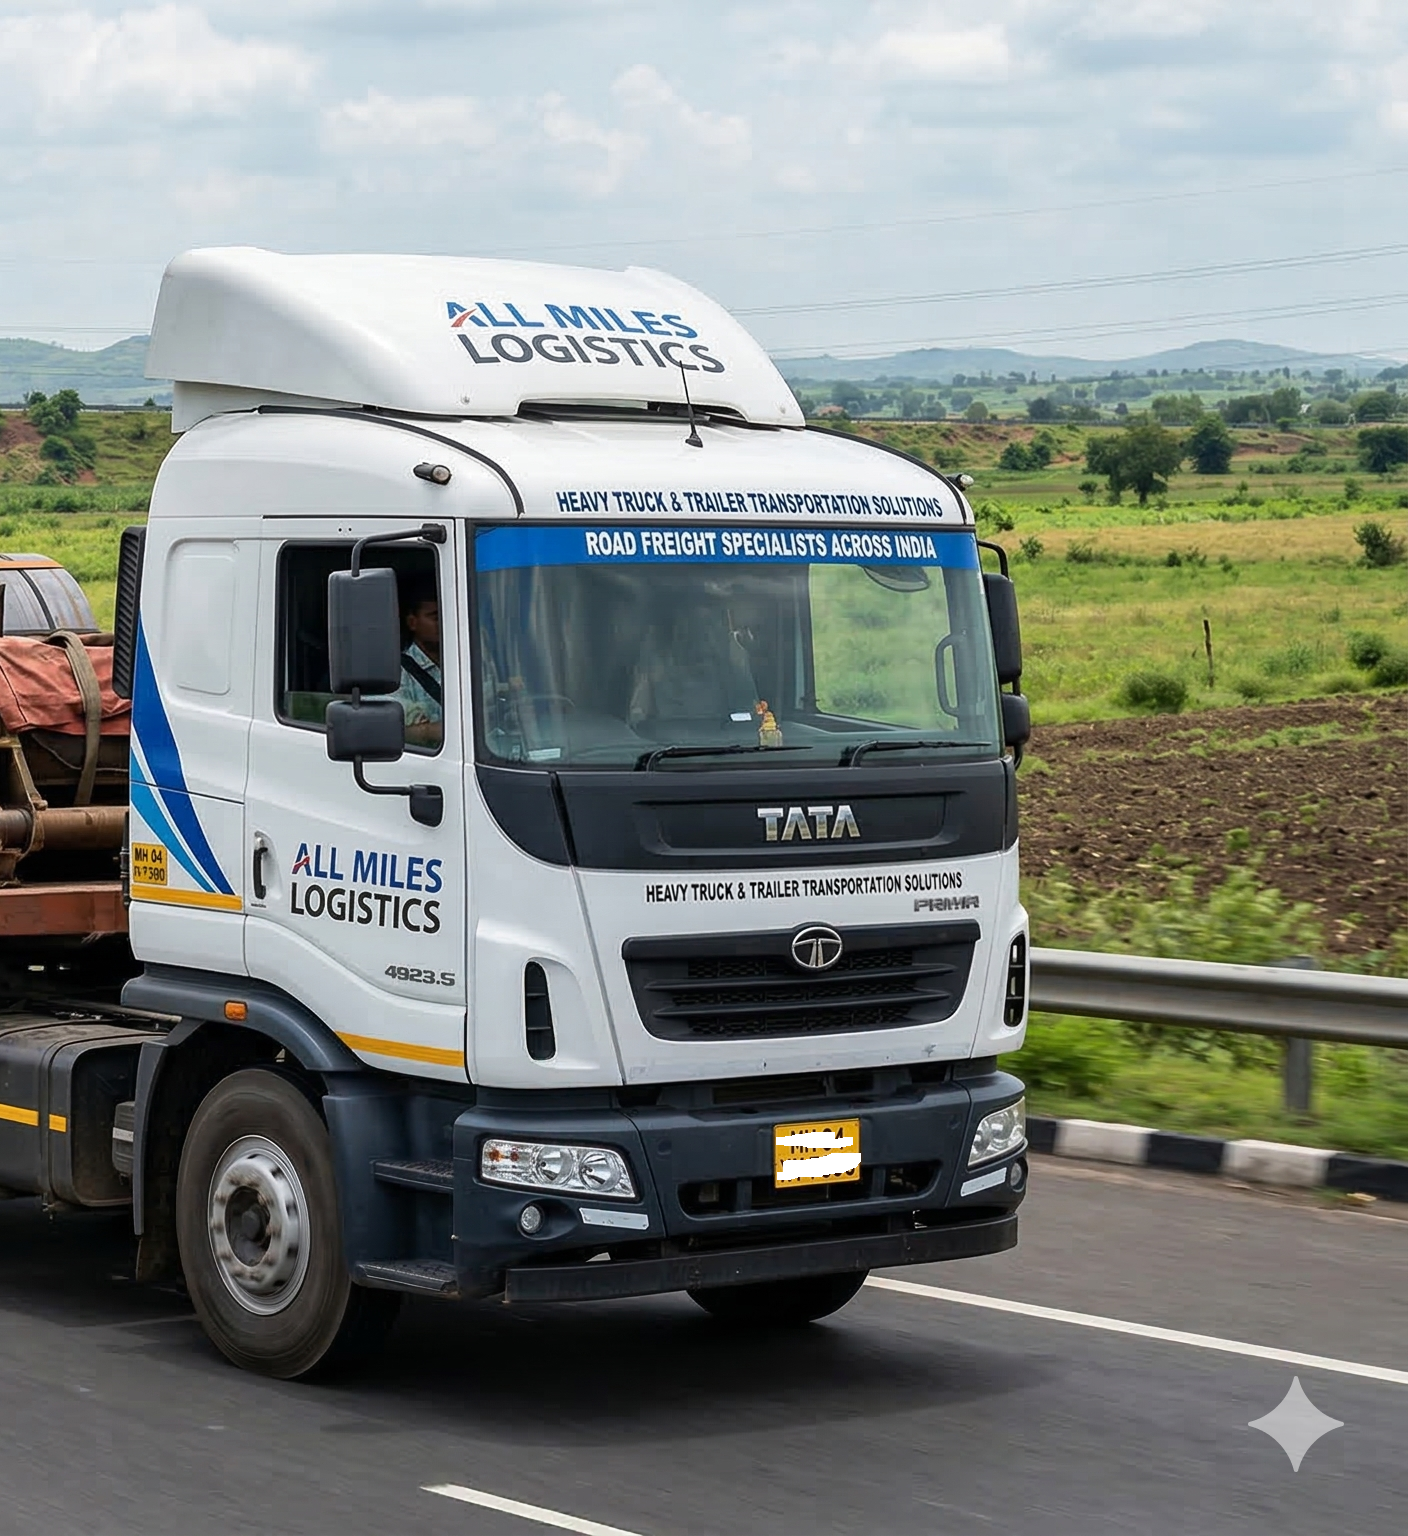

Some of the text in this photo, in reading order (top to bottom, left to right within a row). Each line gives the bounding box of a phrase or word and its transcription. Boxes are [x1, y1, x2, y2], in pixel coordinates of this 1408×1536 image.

[446, 301, 698, 339] ALL MILES
[457, 333, 725, 373] LOGISTICS
[556, 491, 943, 518] HEAVY TRUCK & TRAILER TRANSPORTATION SOLUTIONS
[585, 531, 938, 559] ROAD FREIGHT SPECIALISTS ACROSS INDIA
[757, 804, 861, 841] TATA
[134, 847, 163, 864] MH 04
[292, 842, 443, 893] ALL MILES
[646, 872, 963, 903] HEAVY TRUCK & TRAILER TRANSPORTATION SOLUTIONS
[291, 882, 441, 934] LOGISTICS
